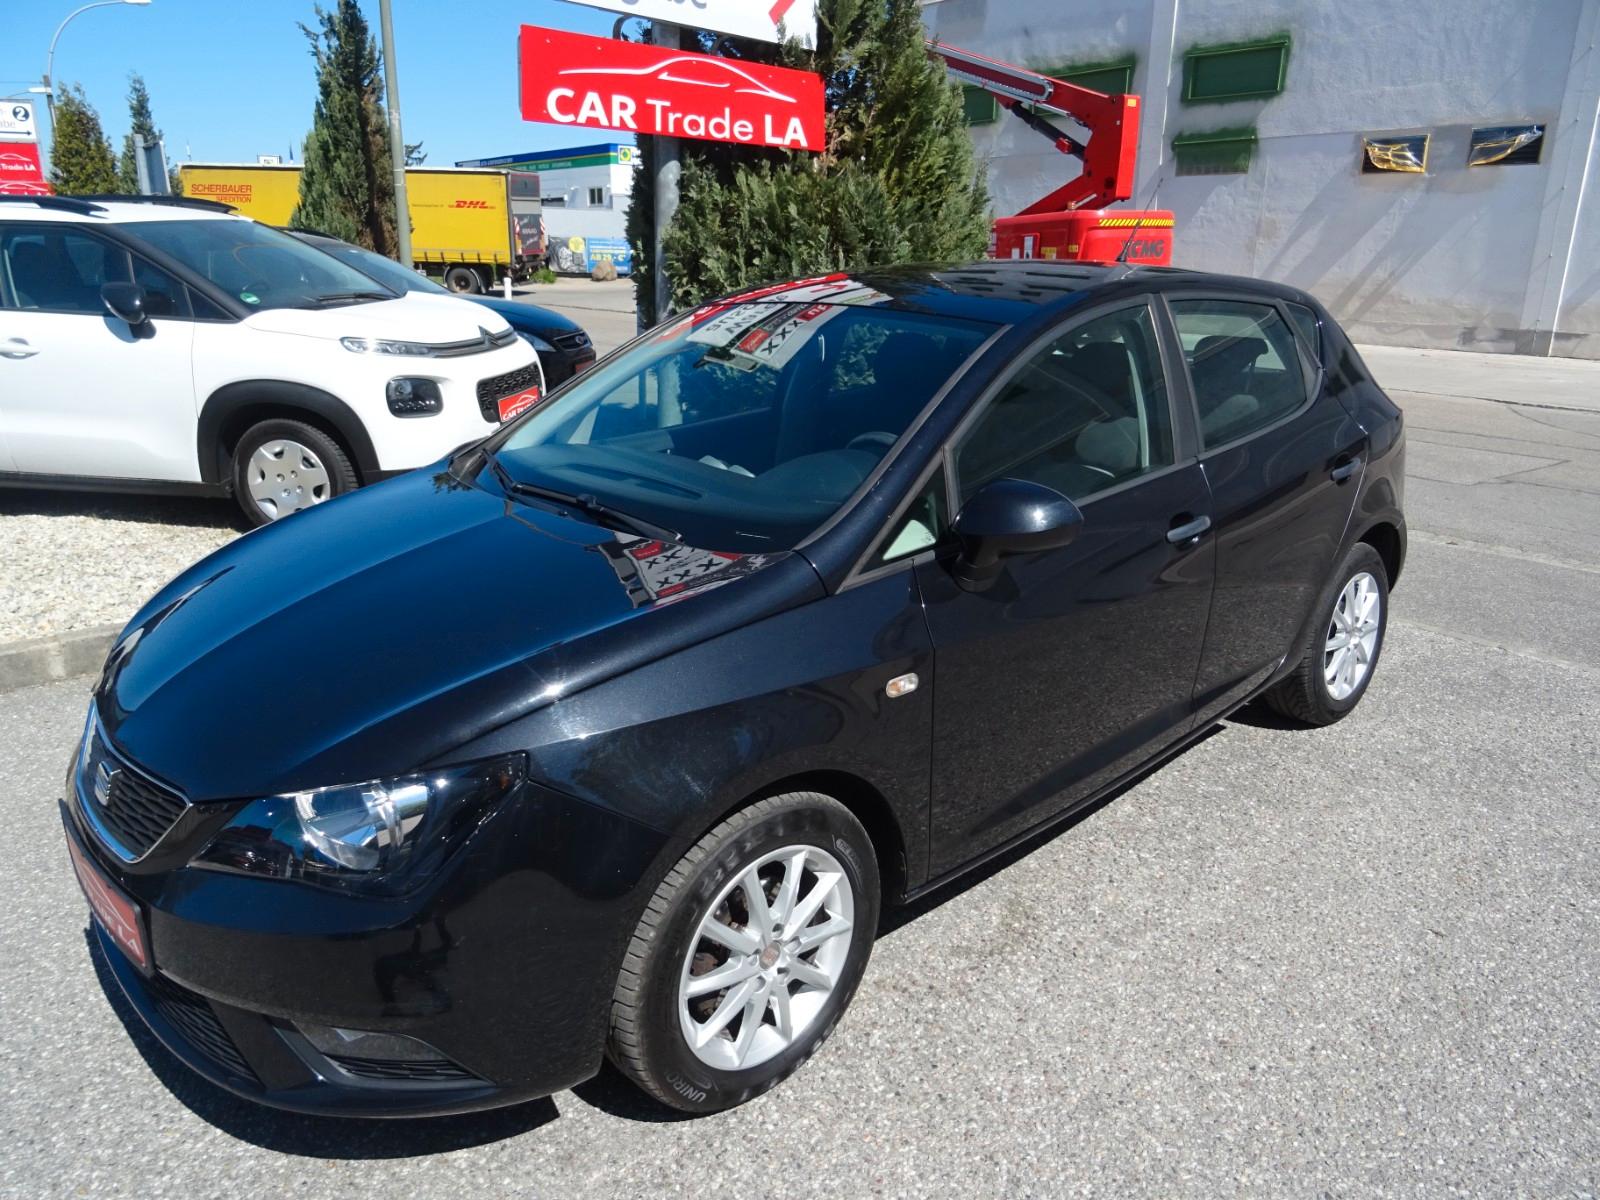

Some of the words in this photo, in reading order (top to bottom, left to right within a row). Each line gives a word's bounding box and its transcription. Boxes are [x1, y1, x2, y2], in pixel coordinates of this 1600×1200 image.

[15, 106, 27, 121] 2
[546, 88, 638, 129] CAR
[646, 98, 754, 141] Trade
[764, 113, 808, 147] LA
[191, 184, 252, 193] SCHERBAUER
[215, 195, 252, 203] SPEDITION
[454, 200, 489, 209] DHL
